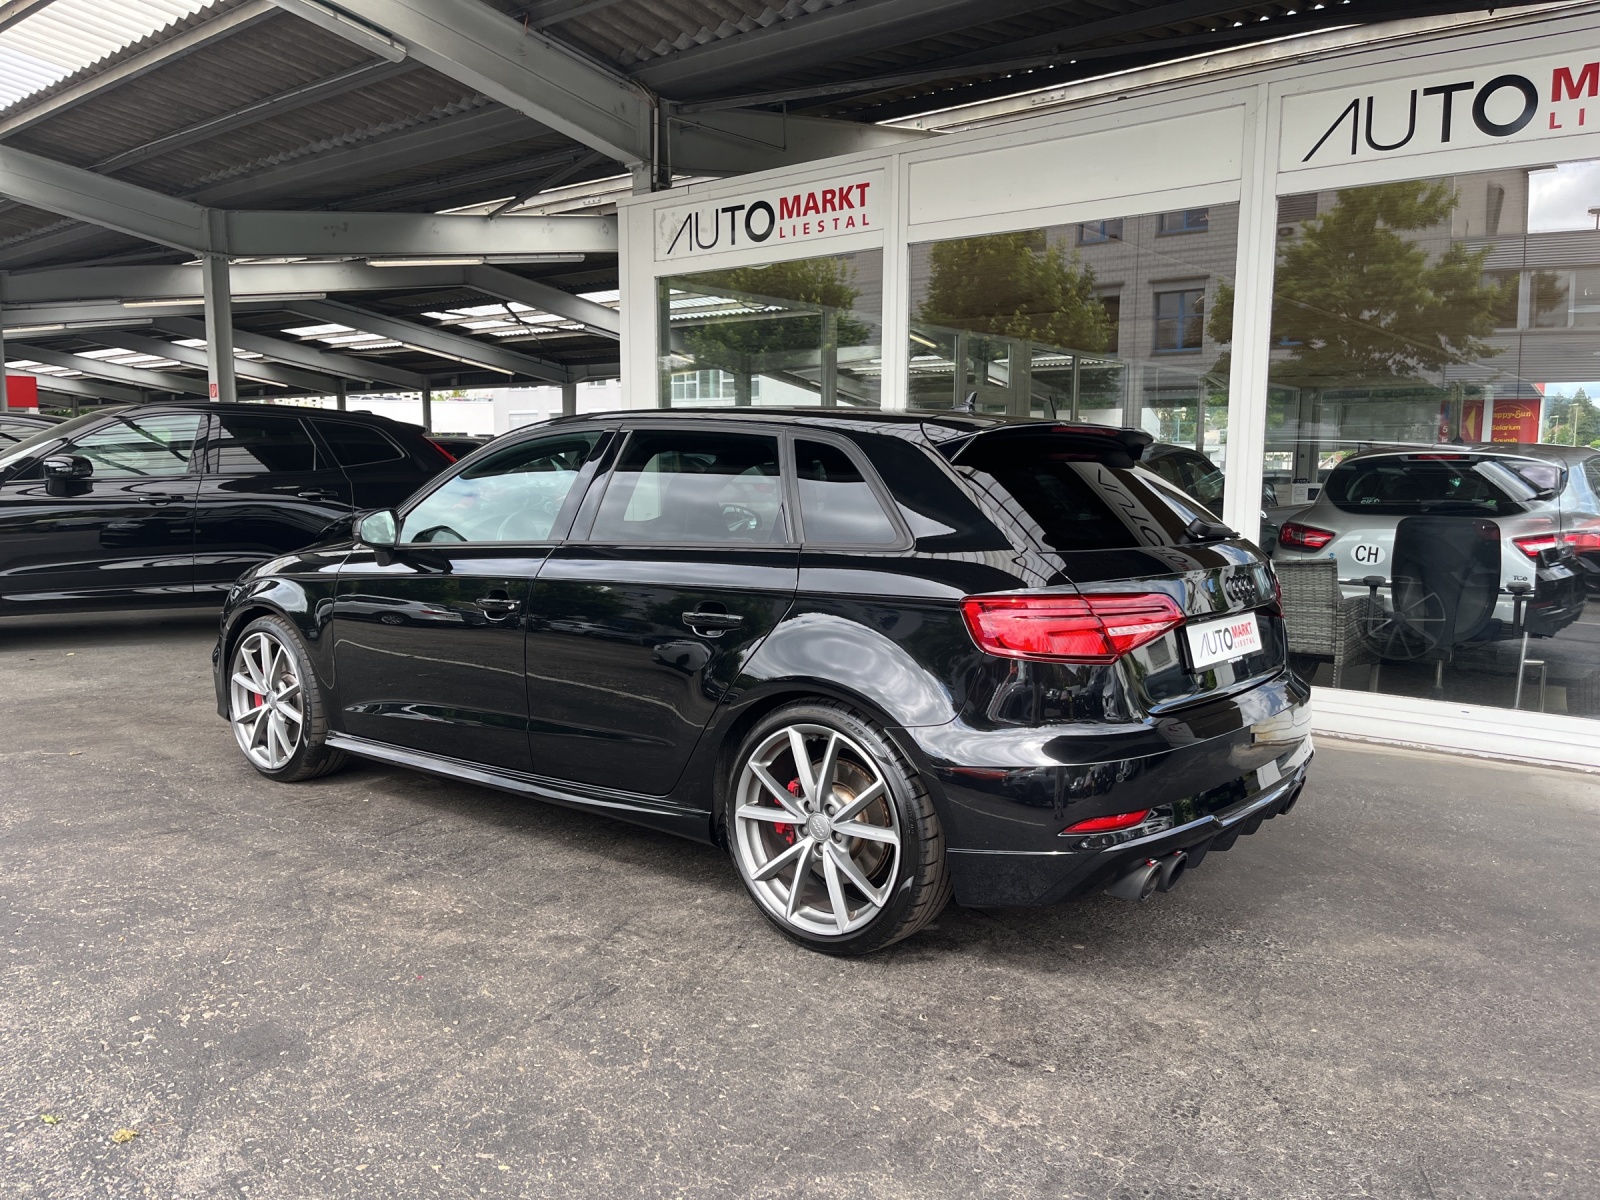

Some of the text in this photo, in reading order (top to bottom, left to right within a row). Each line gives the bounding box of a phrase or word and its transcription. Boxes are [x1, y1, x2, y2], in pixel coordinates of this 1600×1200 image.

[1301, 74, 1539, 163] AUTO
[667, 182, 870, 255] AUTO MARKT
[779, 213, 870, 239] LIESTAL
[1355, 545, 1379, 563] CH
[1200, 622, 1253, 658] AUTO MARKT
